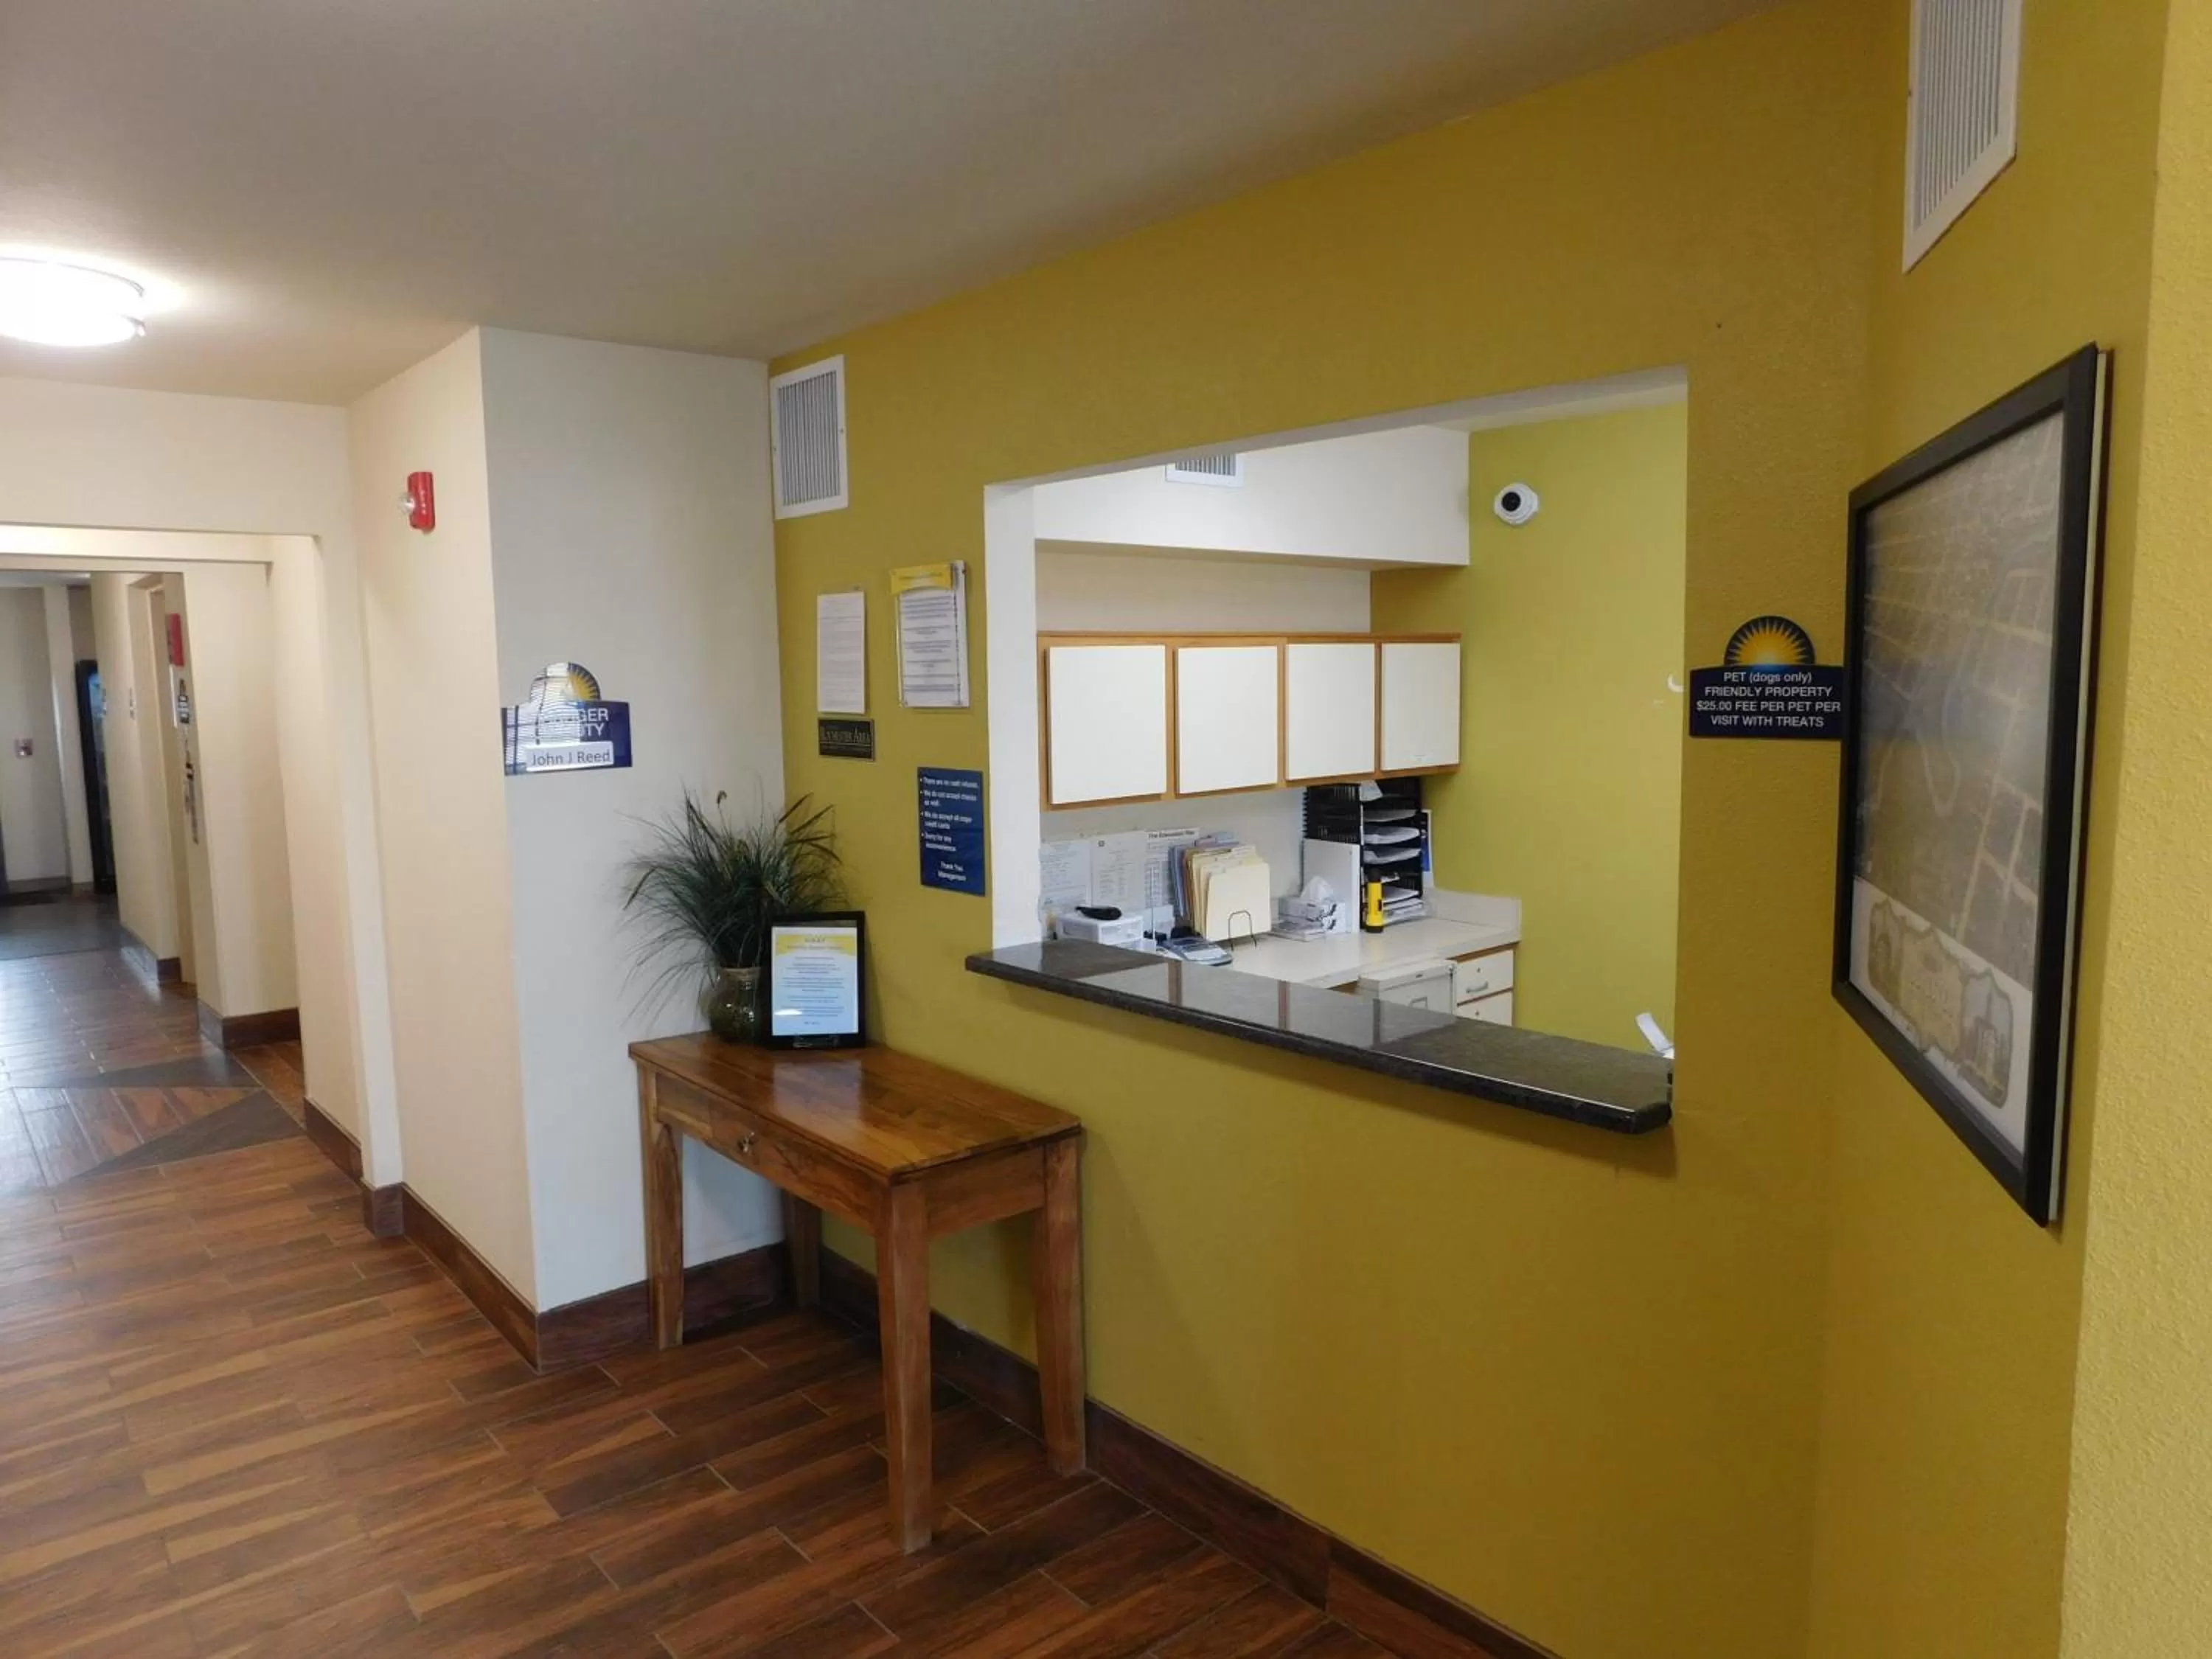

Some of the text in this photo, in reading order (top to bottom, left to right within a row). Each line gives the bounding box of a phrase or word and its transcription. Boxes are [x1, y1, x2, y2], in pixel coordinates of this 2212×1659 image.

[1723, 672, 1812, 684] PET (dogs only)
[1705, 686, 1833, 697] FRIENDLY PROPERTY
[1697, 700, 1841, 712] $25.00 FEE PER PET PER
[1711, 714, 1825, 728] VISIT WITH TREATS
[532, 748, 611, 766] John J Reed
